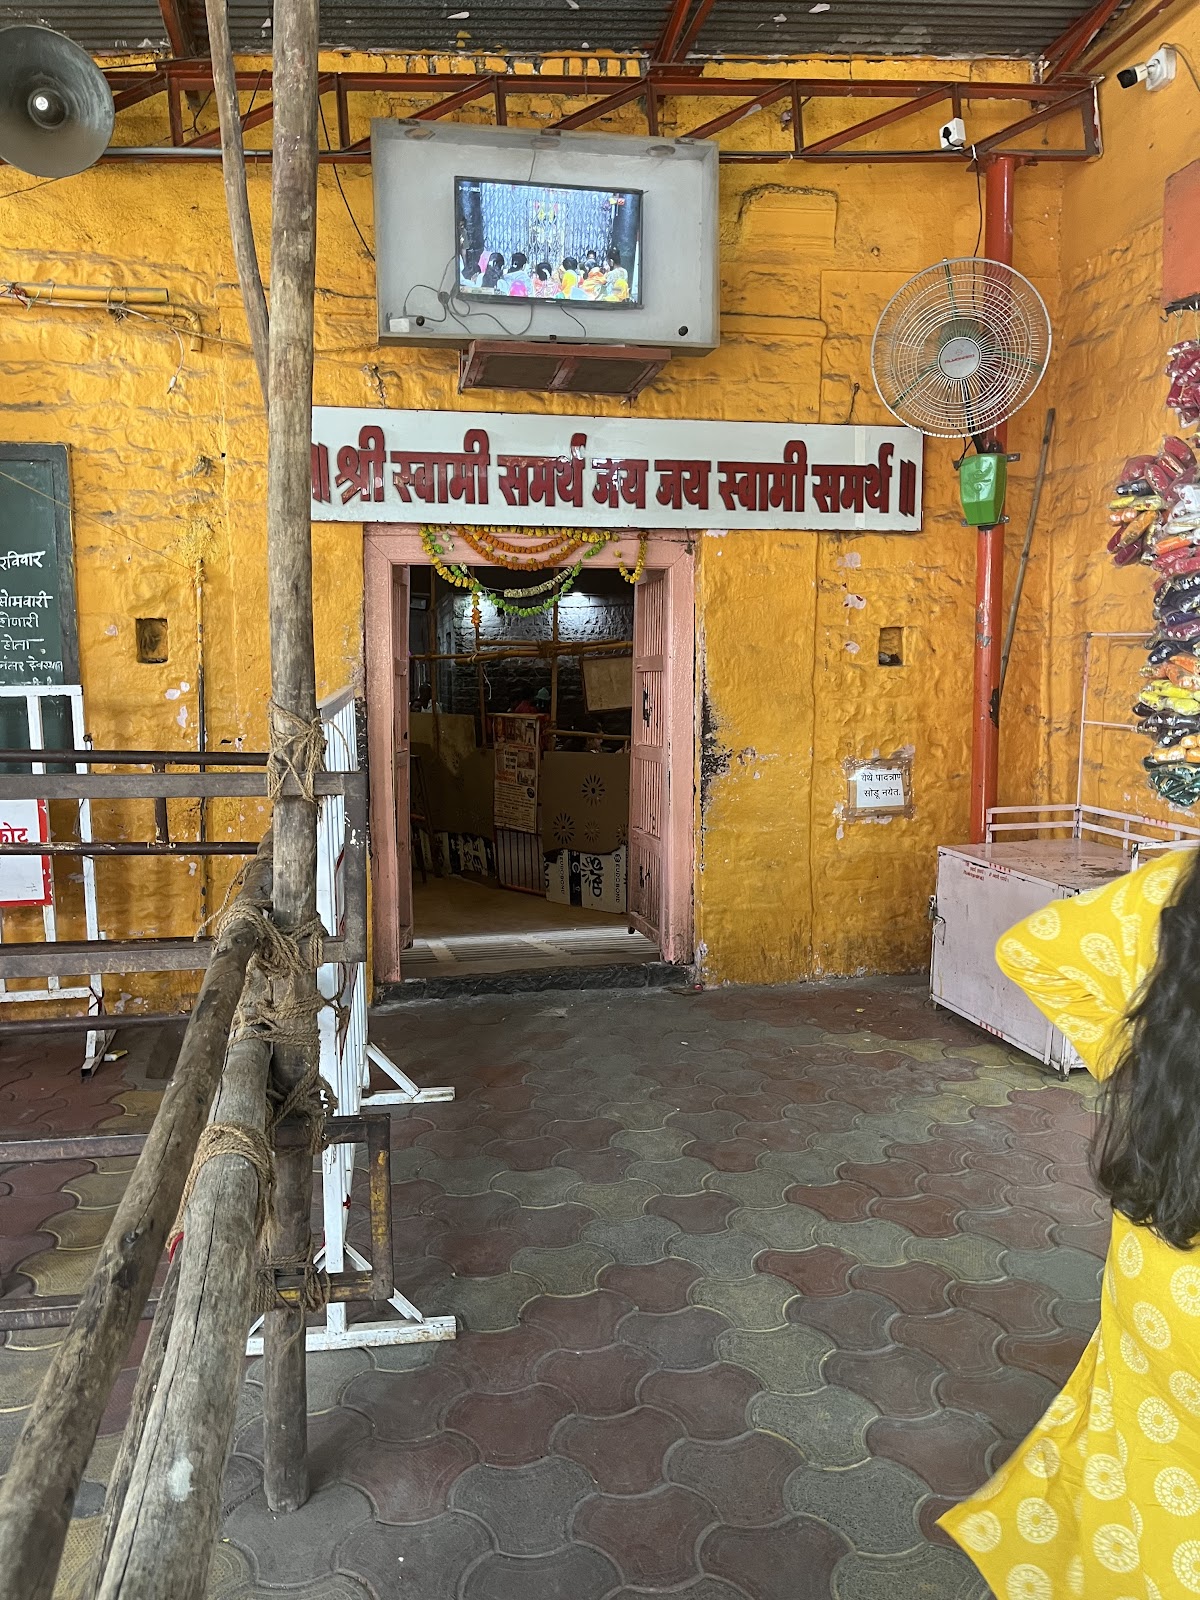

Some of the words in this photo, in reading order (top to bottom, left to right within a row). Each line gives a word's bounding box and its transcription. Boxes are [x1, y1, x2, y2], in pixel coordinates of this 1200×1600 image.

[335, 425, 386, 505] श्री
[390, 429, 490, 505] स्वामी
[497, 433, 587, 508] समर्थ
[591, 457, 648, 509] जय
[654, 459, 711, 510] जय
[717, 440, 808, 512] स्वामी
[811, 442, 895, 513] समर्थ
[861, 772, 873, 782] येथे
[864, 787, 881, 800] सोडू
